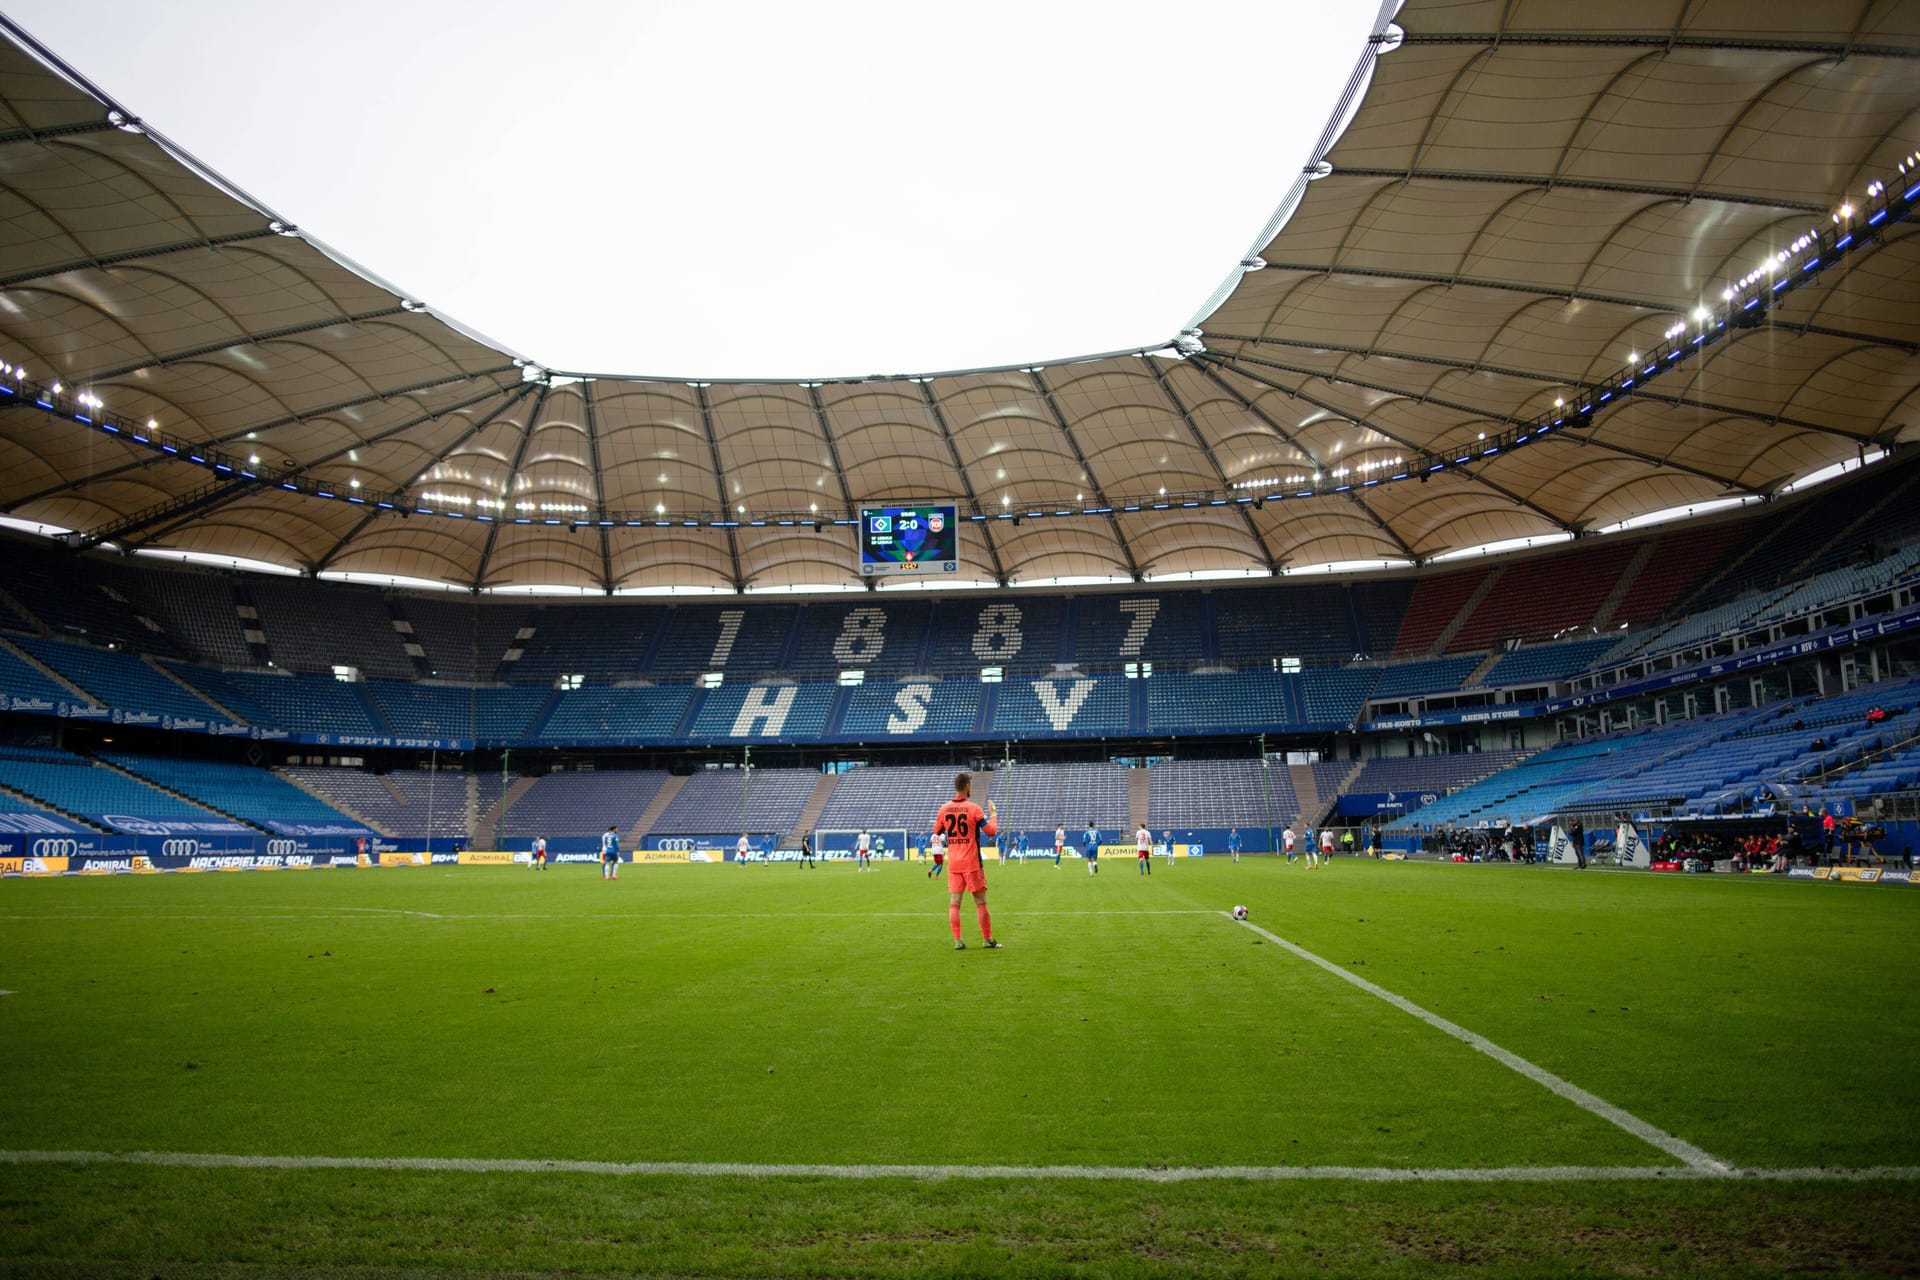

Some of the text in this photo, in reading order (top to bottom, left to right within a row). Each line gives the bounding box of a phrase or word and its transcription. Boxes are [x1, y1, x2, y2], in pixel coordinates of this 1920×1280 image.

[899, 519, 918, 530] 2:0
[1461, 710, 1520, 721] ARENA STORE
[1377, 719, 1421, 729] FAN-KONTO
[945, 814, 969, 837] 26
[1104, 848, 1137, 856] ADMIR
[285, 855, 313, 866] 90+4
[432, 854, 458, 863] 90+4
[470, 854, 512, 862] ADMIRAL
[556, 853, 600, 862] ADMIRAL
[645, 853, 688, 861] ADMIRAL
[82, 859, 131, 870] ADMIRAL
[1861, 870, 1877, 879] BET
